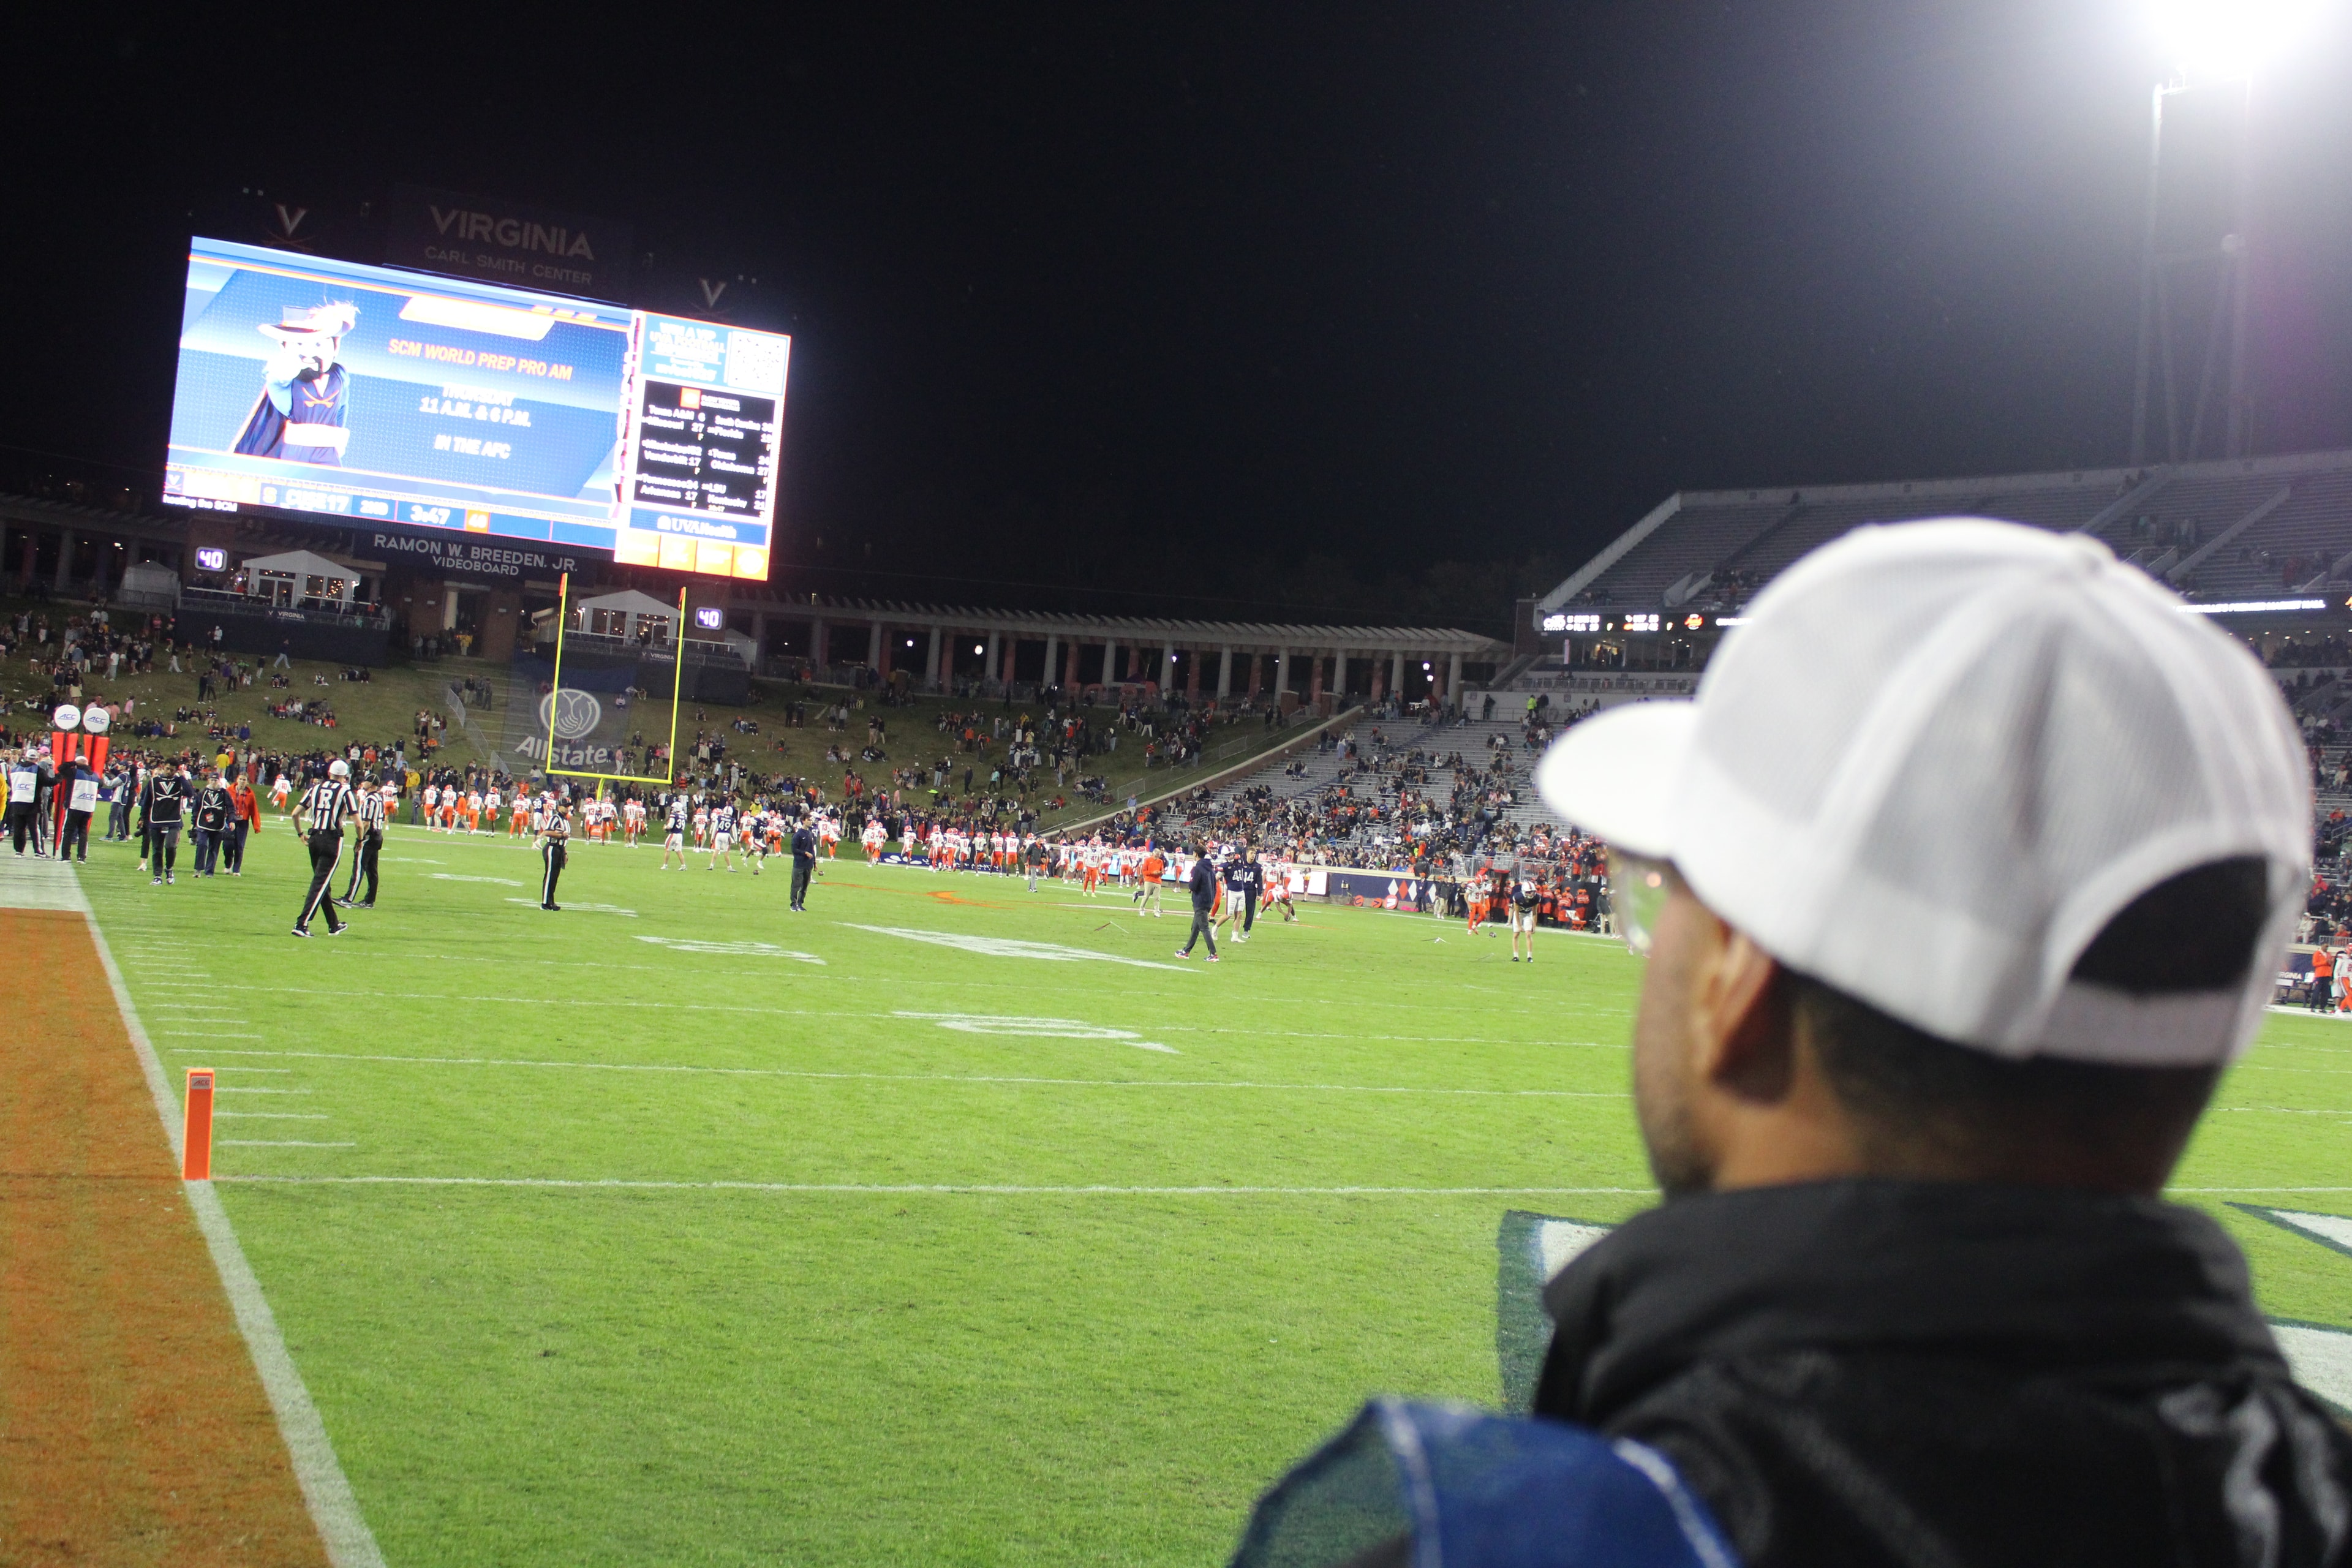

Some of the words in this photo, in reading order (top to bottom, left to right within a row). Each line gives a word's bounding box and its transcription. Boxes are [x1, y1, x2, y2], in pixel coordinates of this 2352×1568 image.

[276, 203, 306, 235] V
[430, 206, 594, 261] VIRGINIA
[424, 246, 469, 265] CARL
[477, 254, 526, 275] SMITH
[532, 264, 592, 285] CENTER
[700, 278, 728, 308] V
[650, 331, 673, 344] UVA
[674, 335, 725, 353] FOOTBALL
[388, 339, 422, 357] SCM
[424, 344, 475, 365] WORLD
[477, 353, 516, 371] PREP
[517, 359, 547, 376] PRO
[549, 364, 573, 380] AM
[442, 382, 518, 407] THURSDAY
[419, 397, 439, 413] 11
[440, 400, 472, 420] A.M.
[475, 405, 488, 420] &
[490, 407, 502, 422] 6
[501, 409, 531, 427] P.M.
[649, 405, 673, 417] Texas
[673, 407, 695, 420] A&M
[715, 415, 734, 427] South
[434, 434, 451, 451] IN
[453, 437, 481, 455] THE
[481, 441, 511, 459] AFC
[712, 449, 736, 461] Texas
[688, 457, 701, 467] 17
[710, 460, 755, 475] Oklahoma
[640, 485, 681, 499] Arkansas
[685, 491, 698, 501] 17
[707, 494, 747, 508] Kentucky
[163, 494, 197, 508] hosting
[198, 499, 213, 508] the
[214, 500, 238, 511] SCM
[671, 518, 701, 535] UVA
[701, 522, 737, 539] Health
[198, 551, 223, 569] 40
[374, 534, 441, 555] RAMON
[448, 543, 463, 557] W.
[552, 557, 578, 571] JR.
[432, 556, 519, 575] VIDEOBOARD
[698, 611, 719, 627] 40
[650, 652, 674, 661] VIRGINIA
[514, 736, 608, 766] Allstate
[317, 789, 333, 809] R
[532, 800, 542, 809] 38
[676, 818, 685, 831] 39
[719, 820, 731, 831] 49
[1244, 872, 1254, 883] 14
